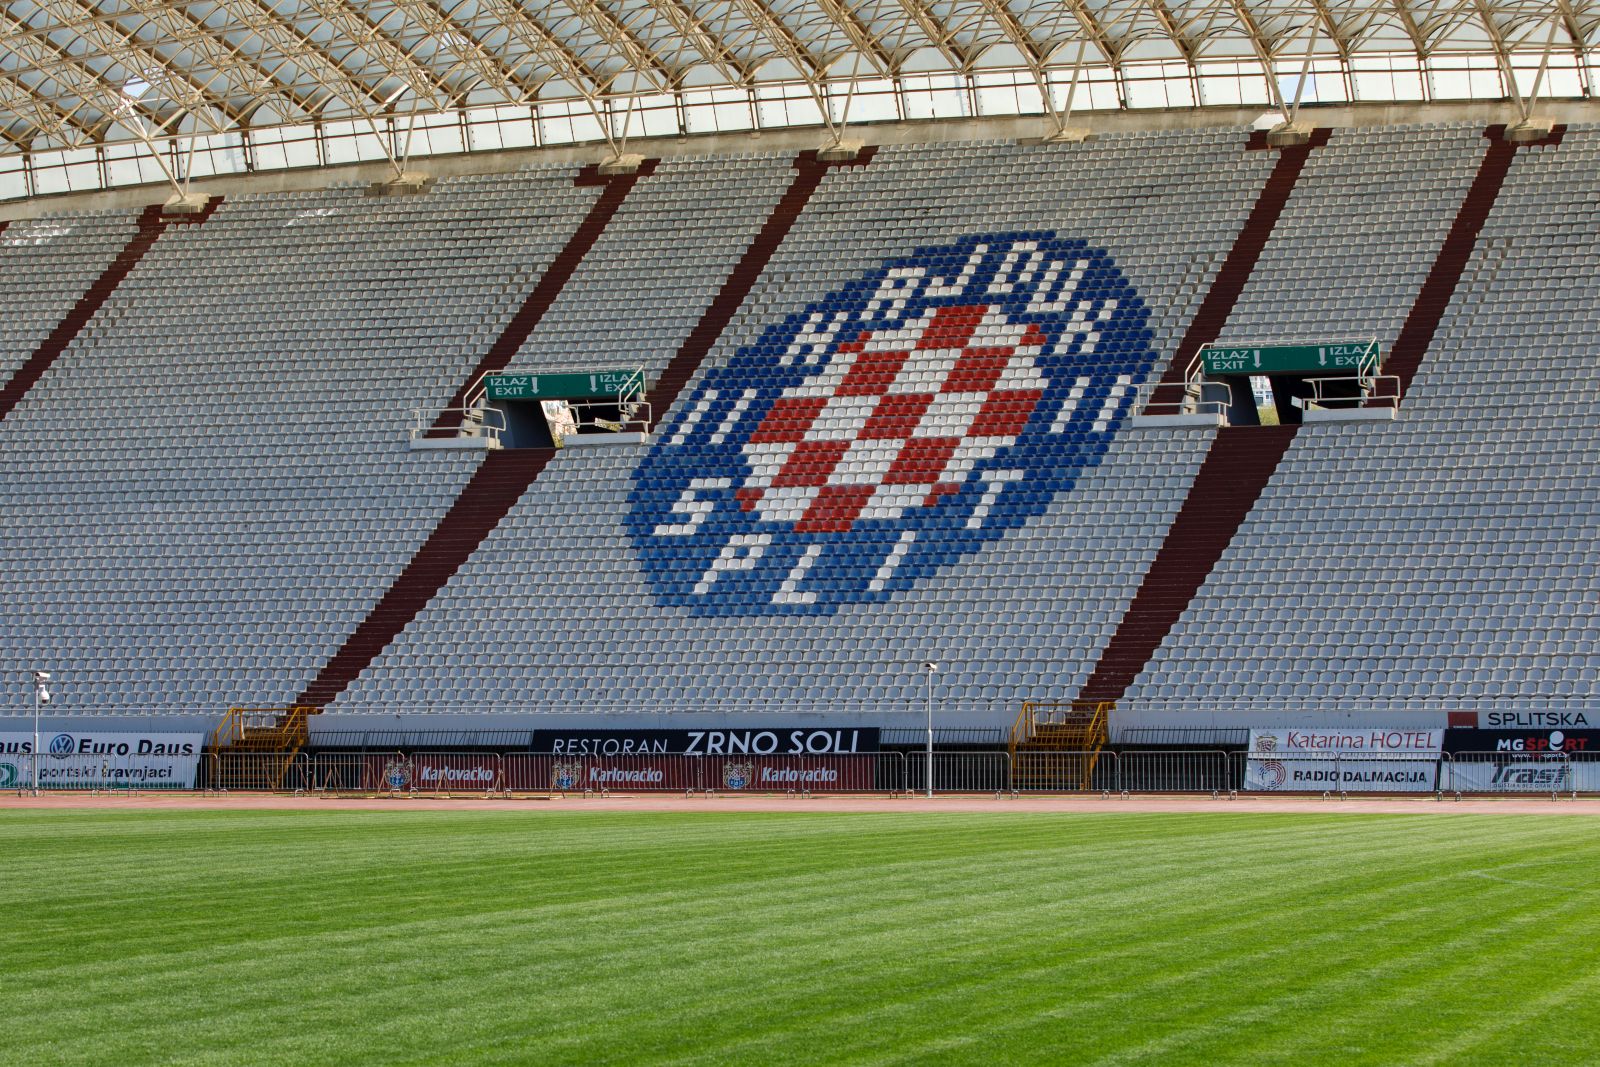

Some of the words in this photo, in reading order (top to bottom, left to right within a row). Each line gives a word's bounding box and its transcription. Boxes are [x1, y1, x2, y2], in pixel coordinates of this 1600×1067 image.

[1207, 350, 1249, 360] IZLAZ
[1329, 345, 1373, 356] IZLAZ
[1212, 361, 1245, 370] EXIT
[1335, 356, 1368, 366] EXIT
[490, 377, 528, 386] IZLAZ
[600, 373, 639, 383] IZLAZ
[495, 387, 524, 396] EXIT
[605, 383, 634, 392] EXIT
[1488, 712, 1588, 726] SPLITSKA
[683, 731, 778, 757] ZRNO
[787, 730, 859, 755] SOLI
[1287, 731, 1364, 749] Katarina
[1370, 731, 1437, 749] HOTEL
[78, 738, 129, 756] Euro
[137, 739, 193, 757] Daus
[552, 738, 668, 756] RESTORAN
[1293, 770, 1339, 782] RADIO
[1343, 771, 1427, 783] DALMACIJA
